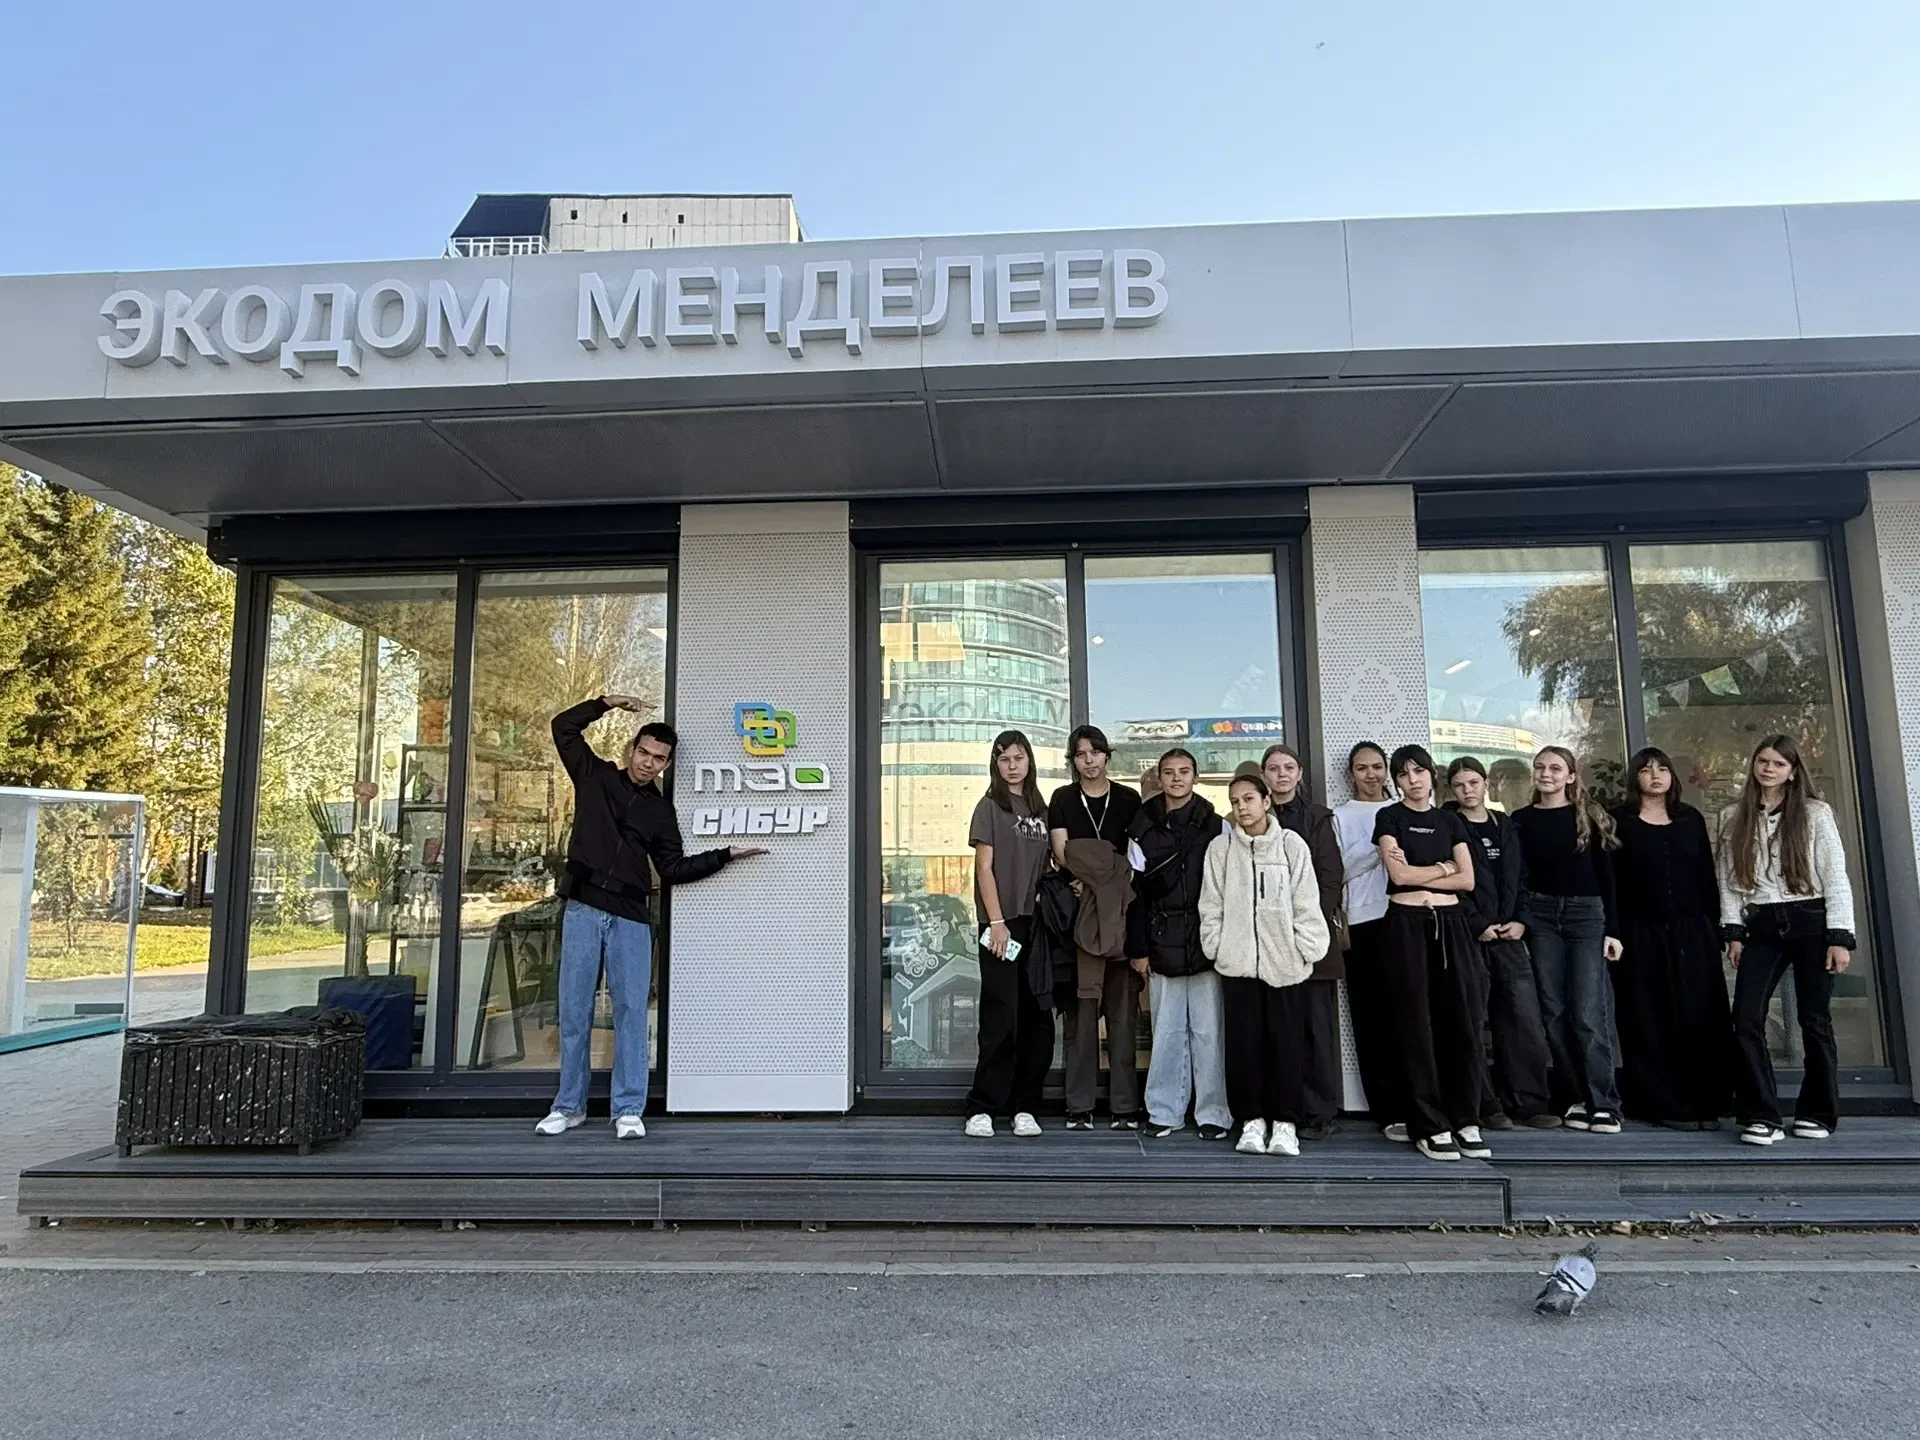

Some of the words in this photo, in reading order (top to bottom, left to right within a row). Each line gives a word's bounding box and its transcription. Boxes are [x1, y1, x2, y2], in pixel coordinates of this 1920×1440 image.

[97, 278, 511, 378] ЭКОДОМ
[576, 248, 1170, 358] МЕНДЕЛЕЕВ
[692, 805, 830, 836] СИБУР
